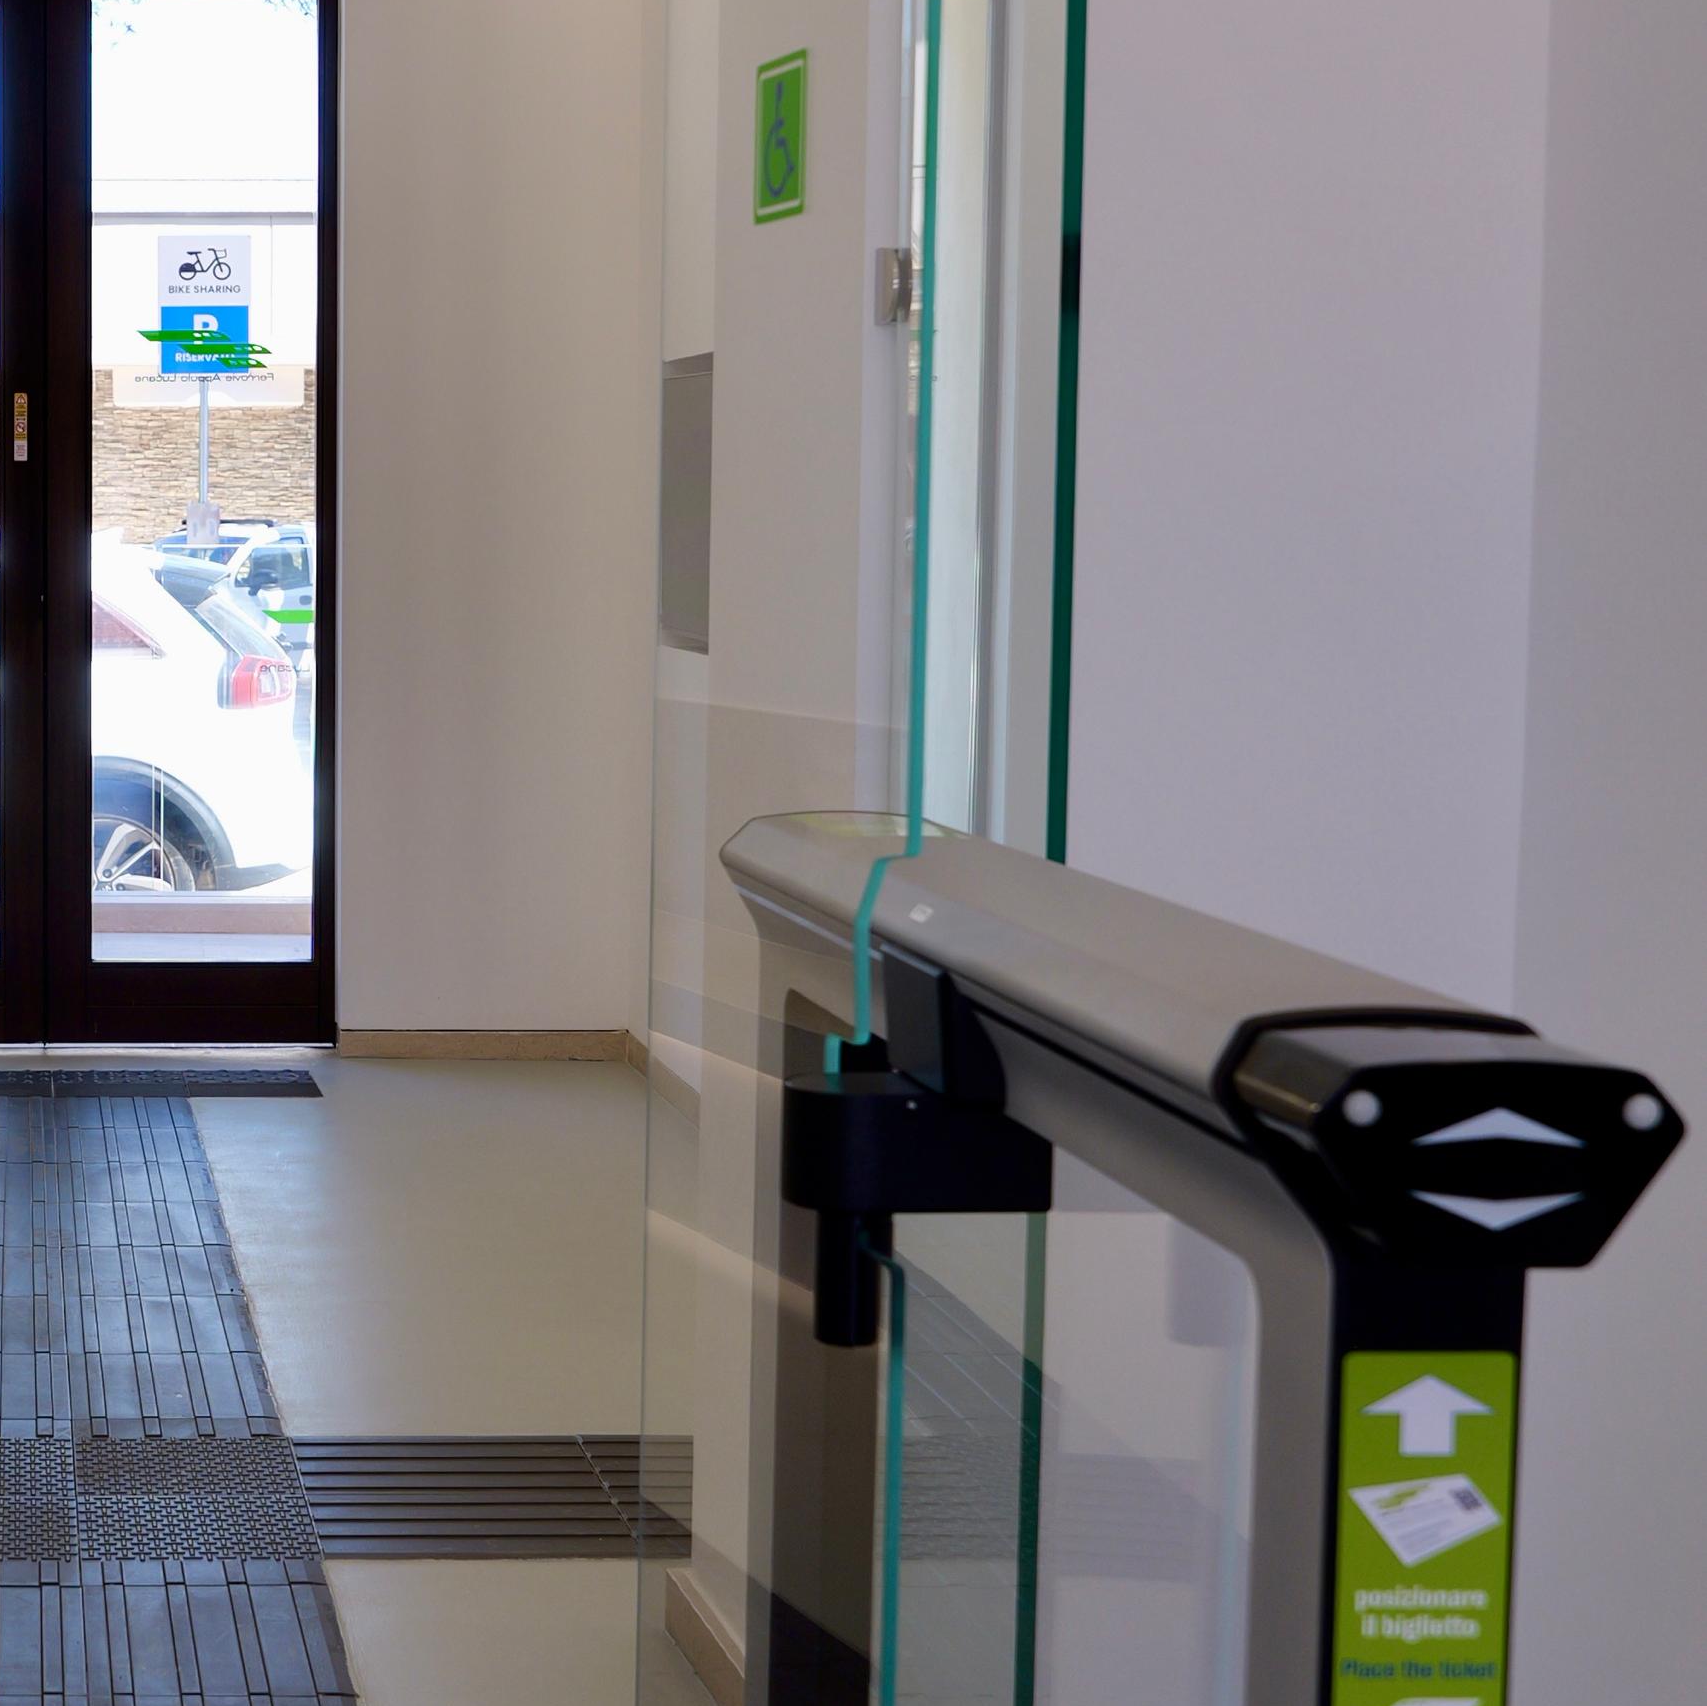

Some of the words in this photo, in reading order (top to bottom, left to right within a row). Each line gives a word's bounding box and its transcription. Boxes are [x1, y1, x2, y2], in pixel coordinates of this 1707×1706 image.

[168, 284, 191, 294] BIKE
[193, 284, 241, 294] SHARING
[193, 313, 219, 345] P
[1355, 1586, 1488, 1612] posizionare
[1361, 1614, 1378, 1637] il
[1382, 1614, 1480, 1643] biglietto
[1342, 1658, 1395, 1678] Place
[1401, 1659, 1433, 1678] the
[1439, 1659, 1497, 1678] ticket
